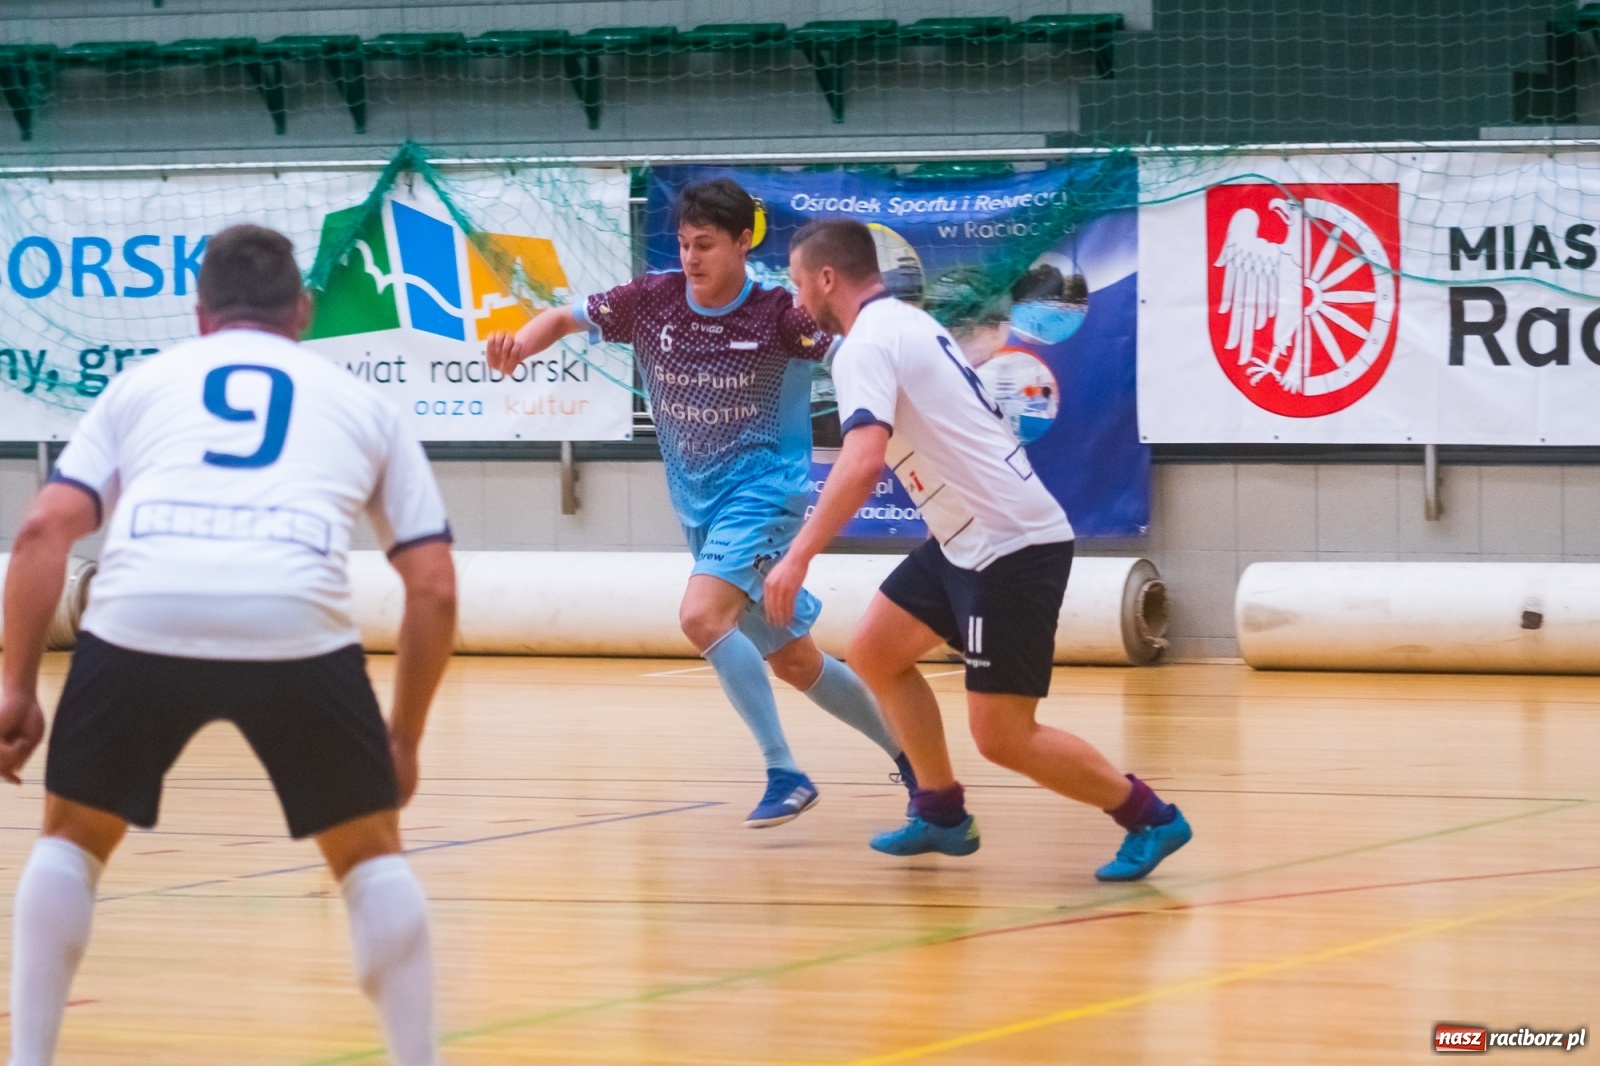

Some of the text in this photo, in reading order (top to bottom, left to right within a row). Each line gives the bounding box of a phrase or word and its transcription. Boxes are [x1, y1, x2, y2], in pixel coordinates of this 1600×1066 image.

[887, 196, 957, 216] Sportu
[961, 196, 971, 211] i
[937, 226, 958, 238] w
[0, 235, 211, 299] ORSK
[660, 324, 675, 352] 6
[203, 364, 294, 470] 9
[414, 400, 483, 416] oaza
[660, 399, 758, 425] AGROTIM
